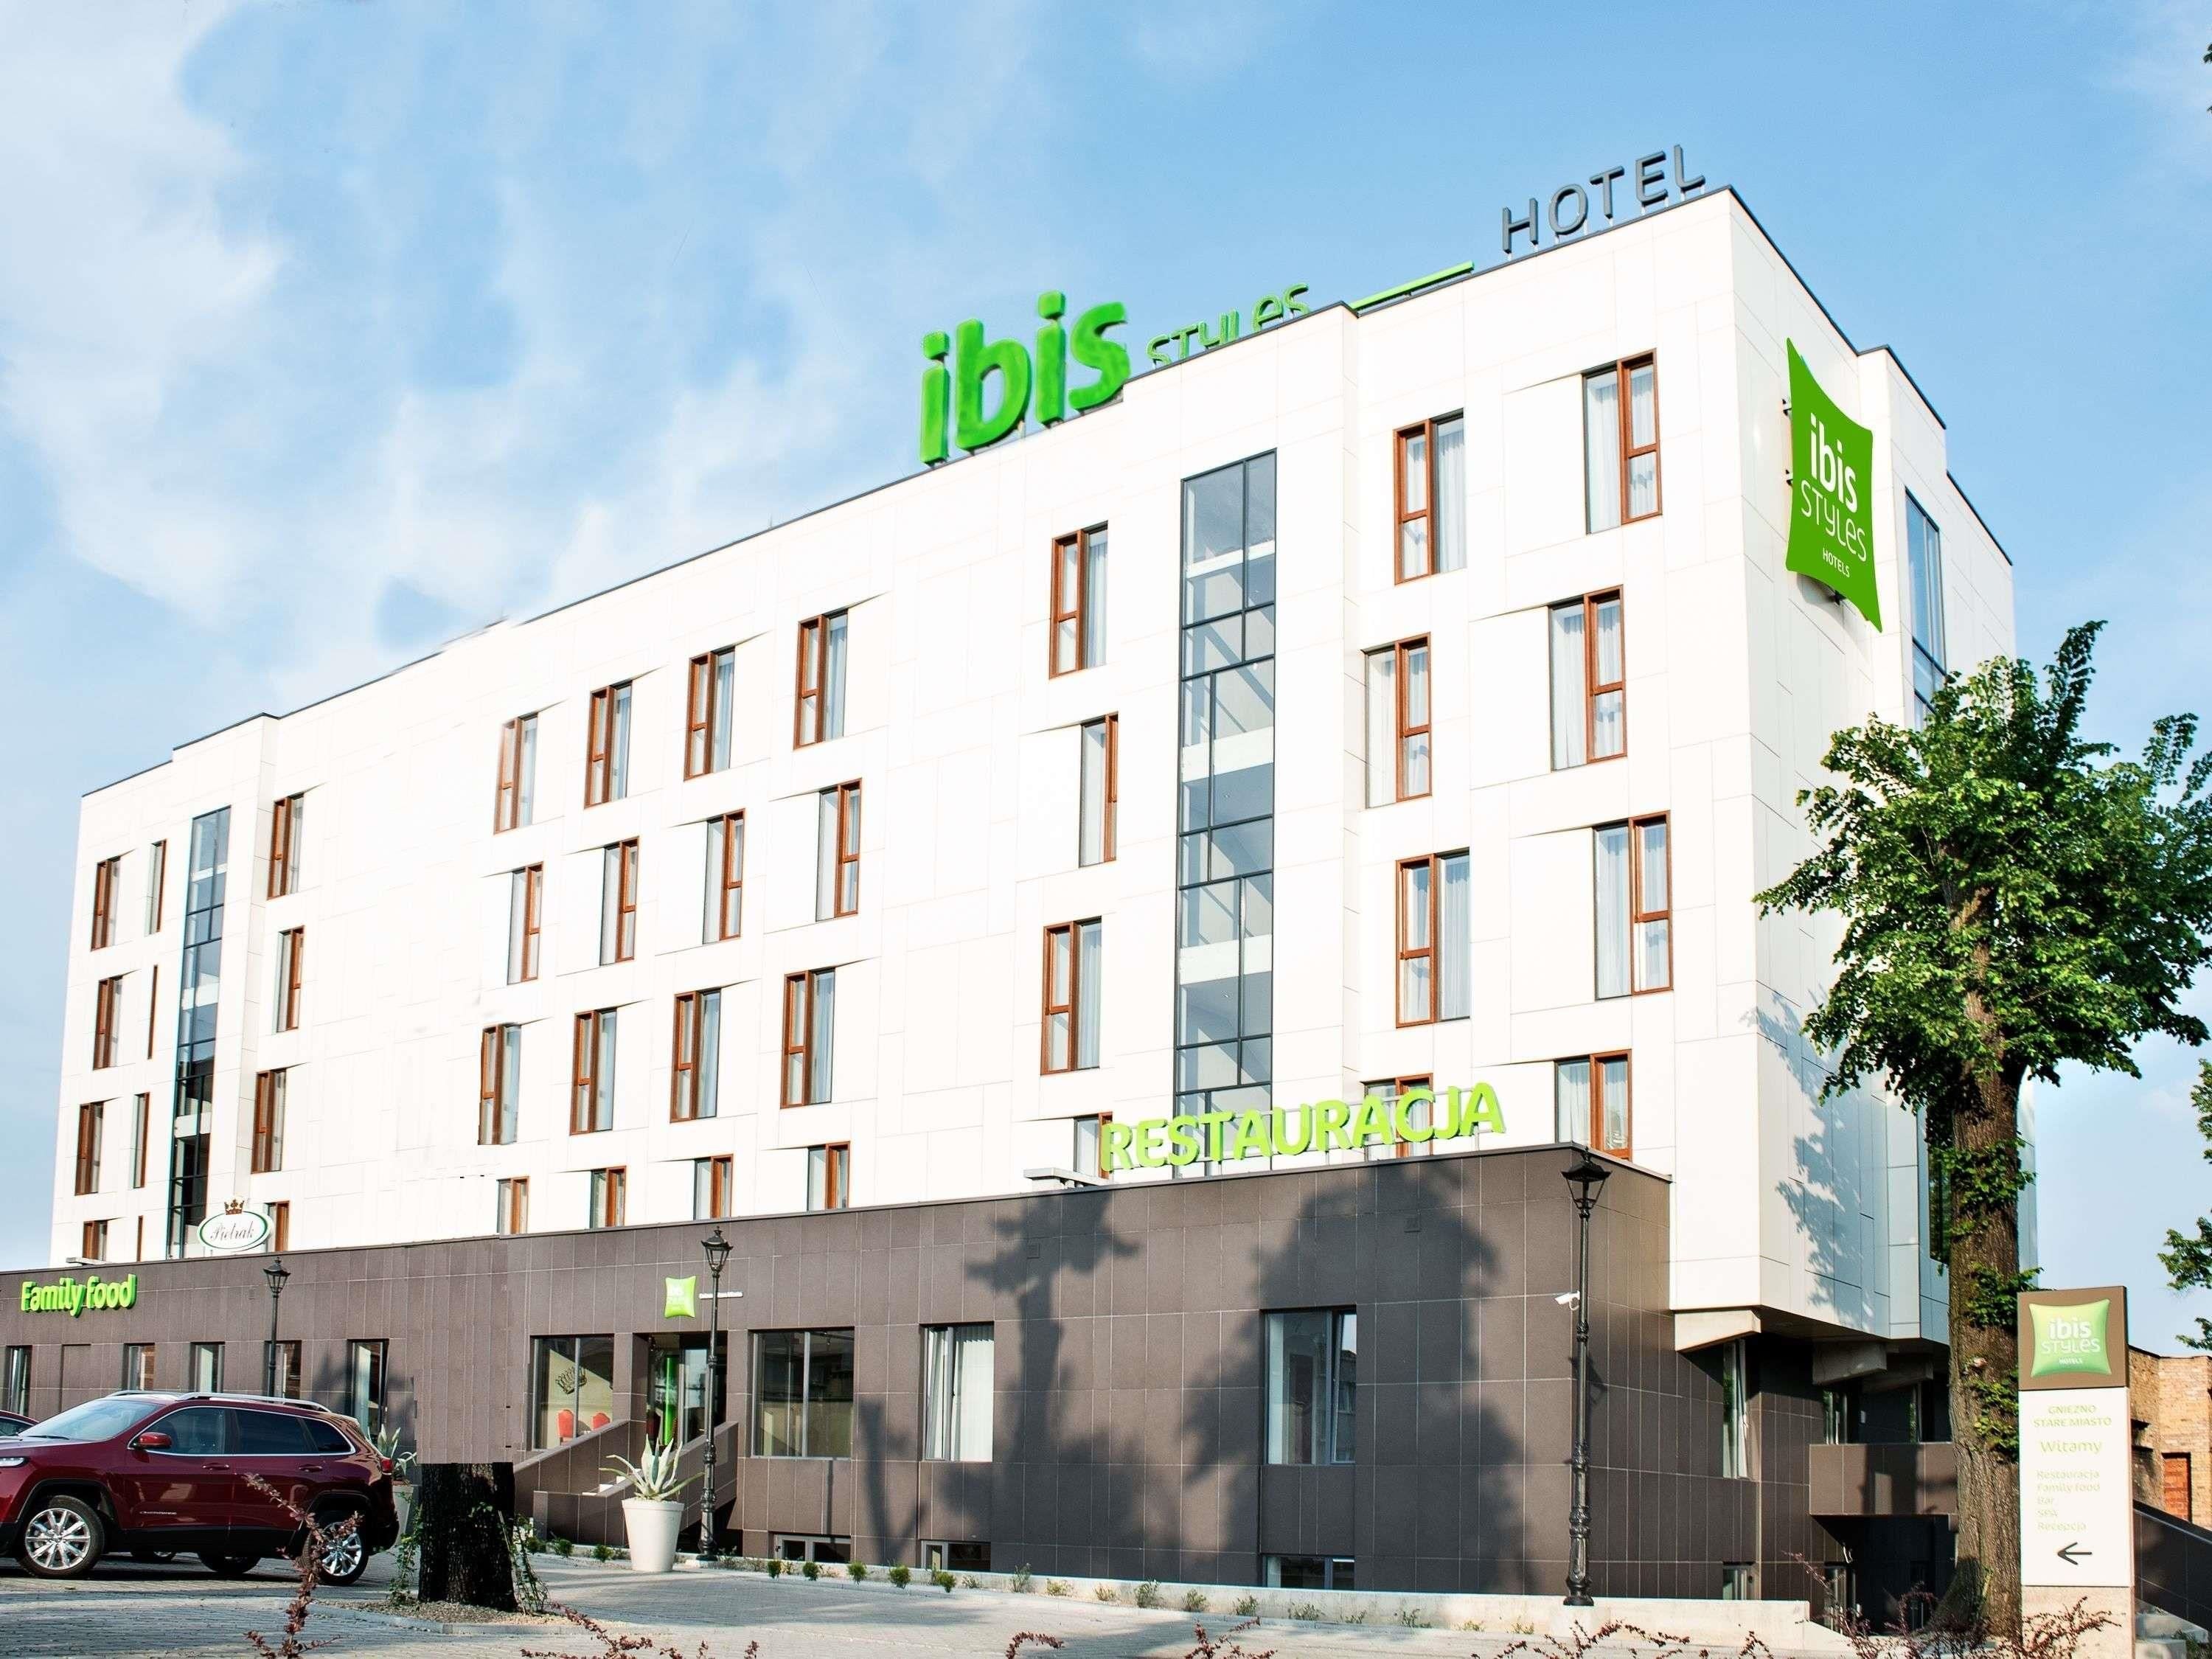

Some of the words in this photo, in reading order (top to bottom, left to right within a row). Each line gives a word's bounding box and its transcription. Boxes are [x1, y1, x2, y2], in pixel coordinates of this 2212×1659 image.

[1502, 144, 1705, 254] HOTEL
[919, 289, 1131, 466] ibis
[1809, 411, 1858, 514] ibis
[1822, 546, 1851, 578] HOTELS
[1100, 1082, 1506, 1172] RESTAURACJA
[21, 1277, 86, 1318] Family
[86, 1273, 138, 1310] food
[2048, 1316, 2093, 1339] ibis
[2033, 1418, 2068, 1428] STARE
[2069, 1416, 2112, 1427] MIASTO
[2048, 1404, 2097, 1415] GNIEZNO
[2039, 1440, 2102, 1455] Witamy
